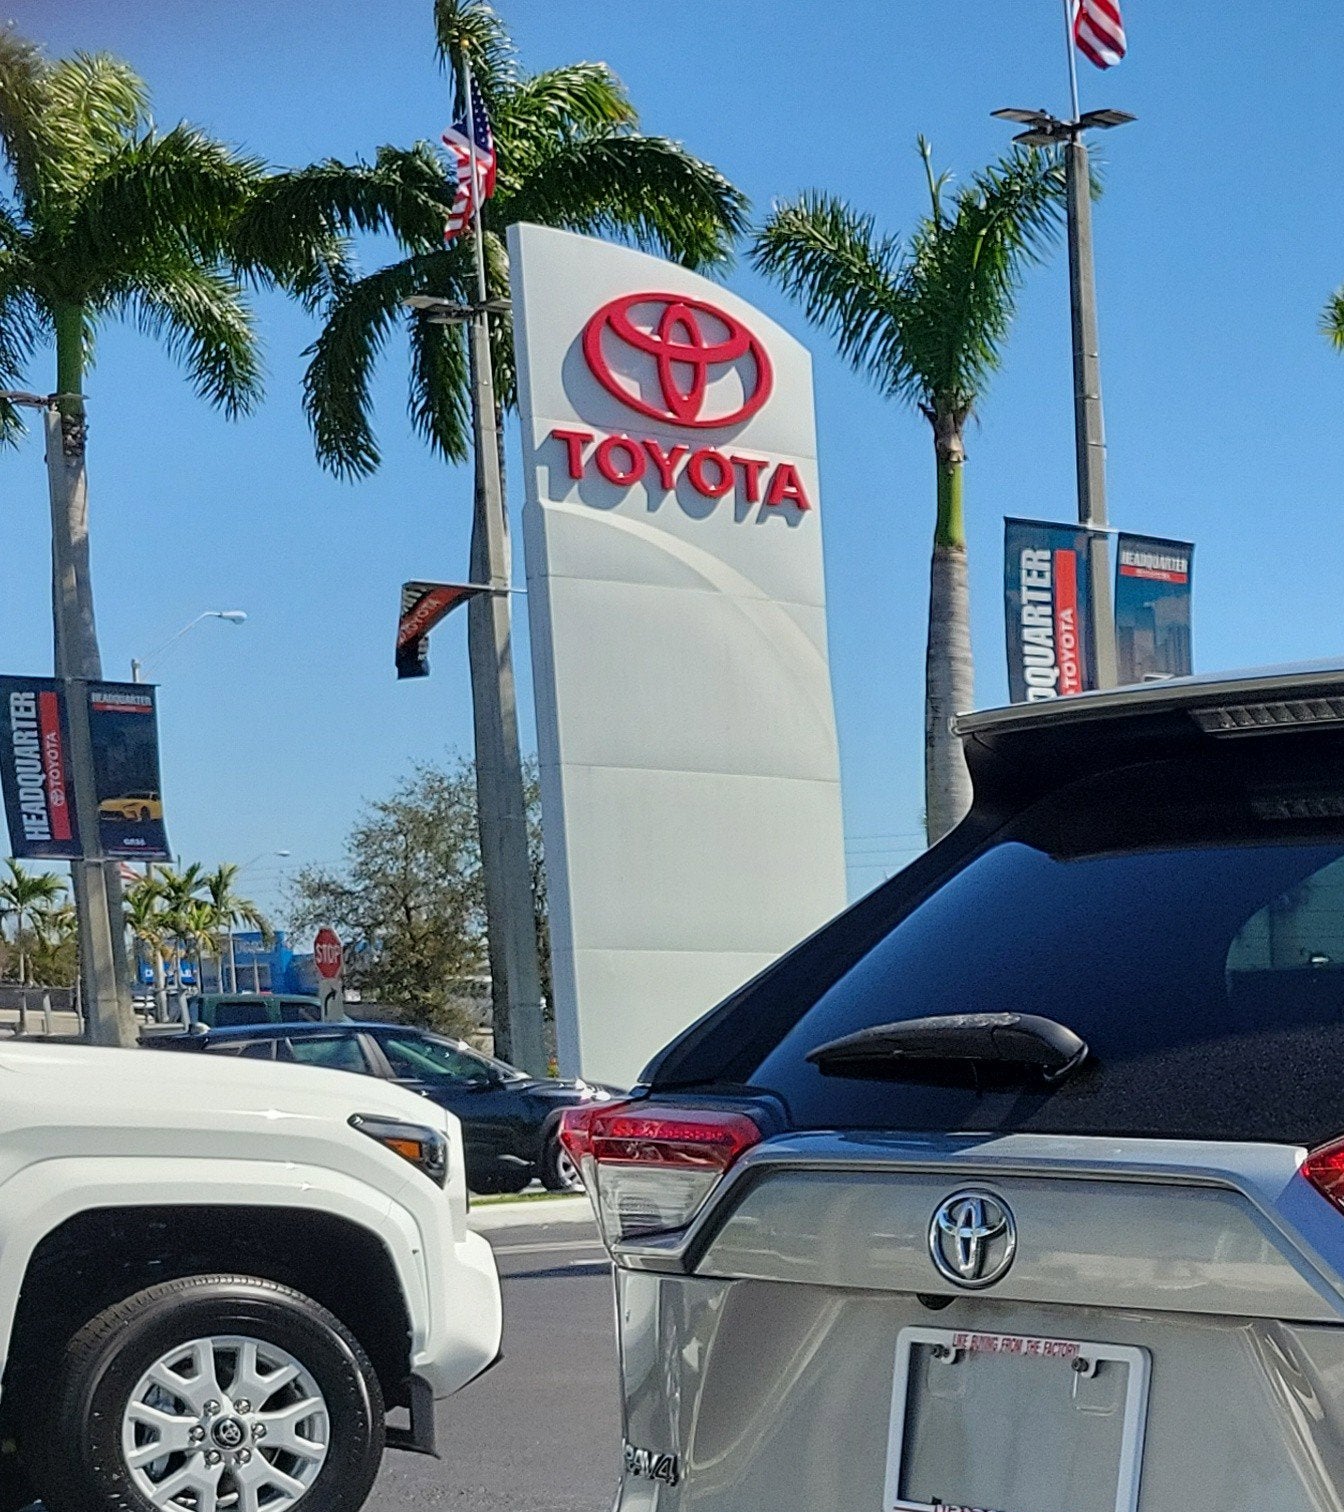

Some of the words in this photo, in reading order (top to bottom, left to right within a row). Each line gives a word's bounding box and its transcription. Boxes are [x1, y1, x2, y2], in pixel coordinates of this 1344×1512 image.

[551, 429, 811, 511] TOYOTA
[1021, 549, 1060, 702] DQUARTER
[1059, 606, 1078, 690] TOYOTA
[10, 691, 51, 841] HEADQUARTER
[45, 730, 63, 790] TOYOTA
[315, 943, 341, 964] STOP
